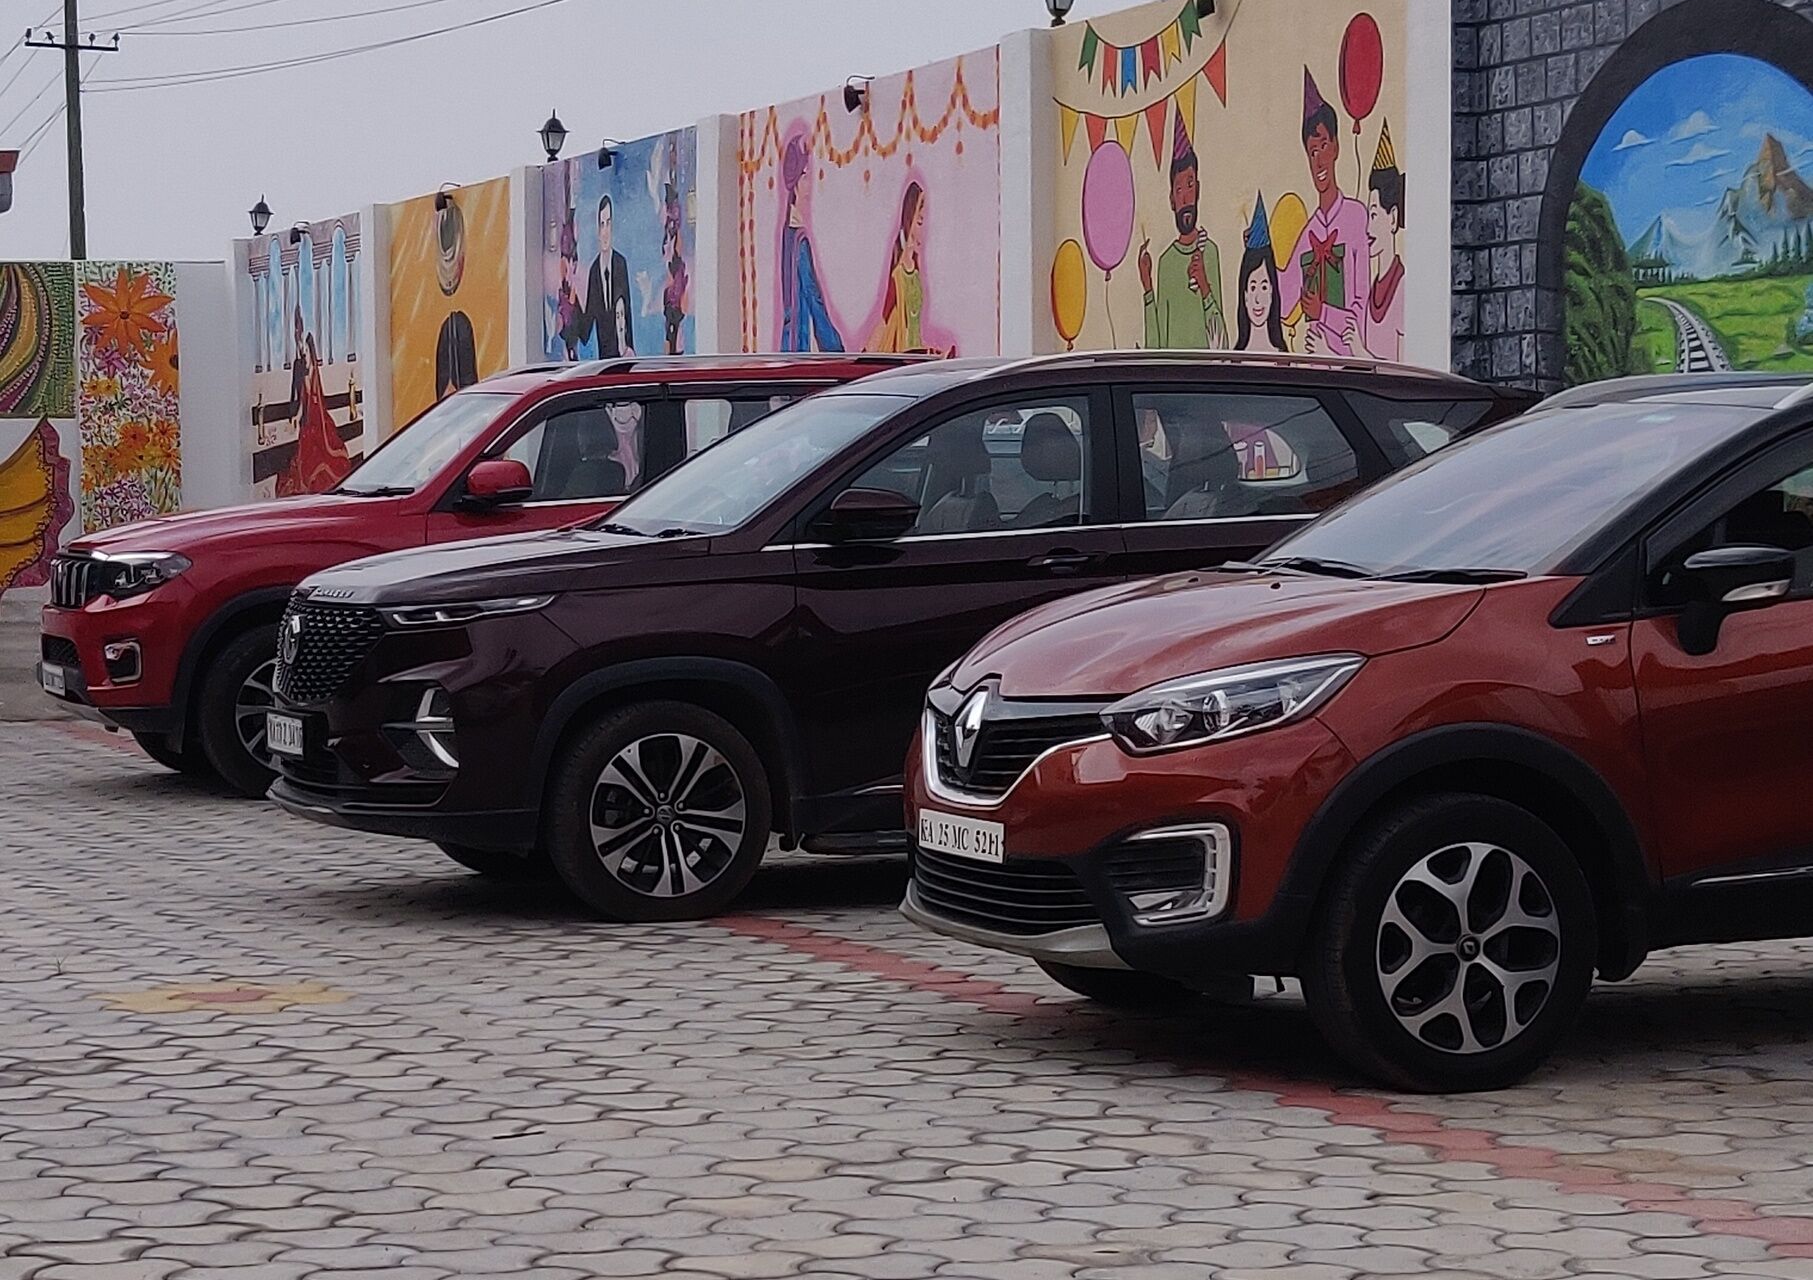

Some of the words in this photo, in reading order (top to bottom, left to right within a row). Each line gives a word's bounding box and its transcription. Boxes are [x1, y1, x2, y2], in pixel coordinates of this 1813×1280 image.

[921, 818, 934, 844] KA
[938, 822, 949, 847] 25
[952, 824, 970, 851] MC
